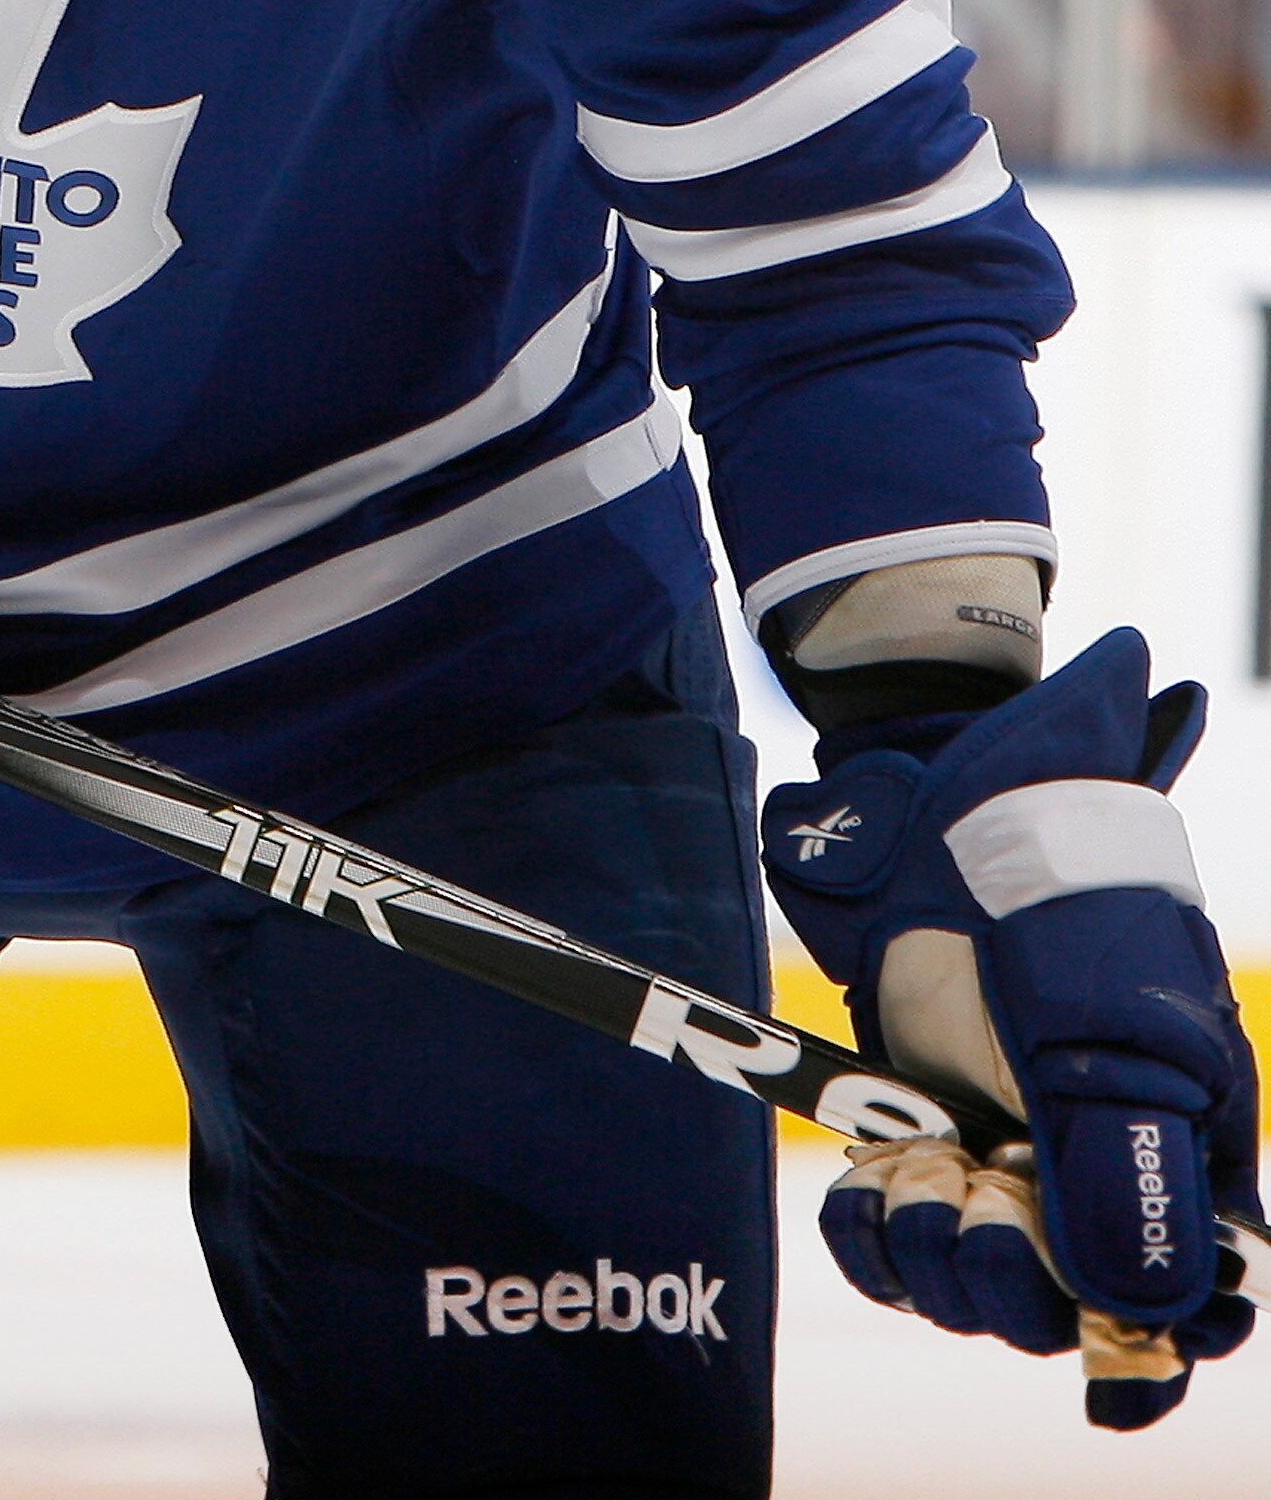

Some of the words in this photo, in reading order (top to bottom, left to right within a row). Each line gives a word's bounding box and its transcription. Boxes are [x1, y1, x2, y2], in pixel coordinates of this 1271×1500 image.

[212, 807, 417, 952] 11K
[1127, 1122, 1176, 1271] Reebok
[425, 1257, 729, 1342] Reebok
